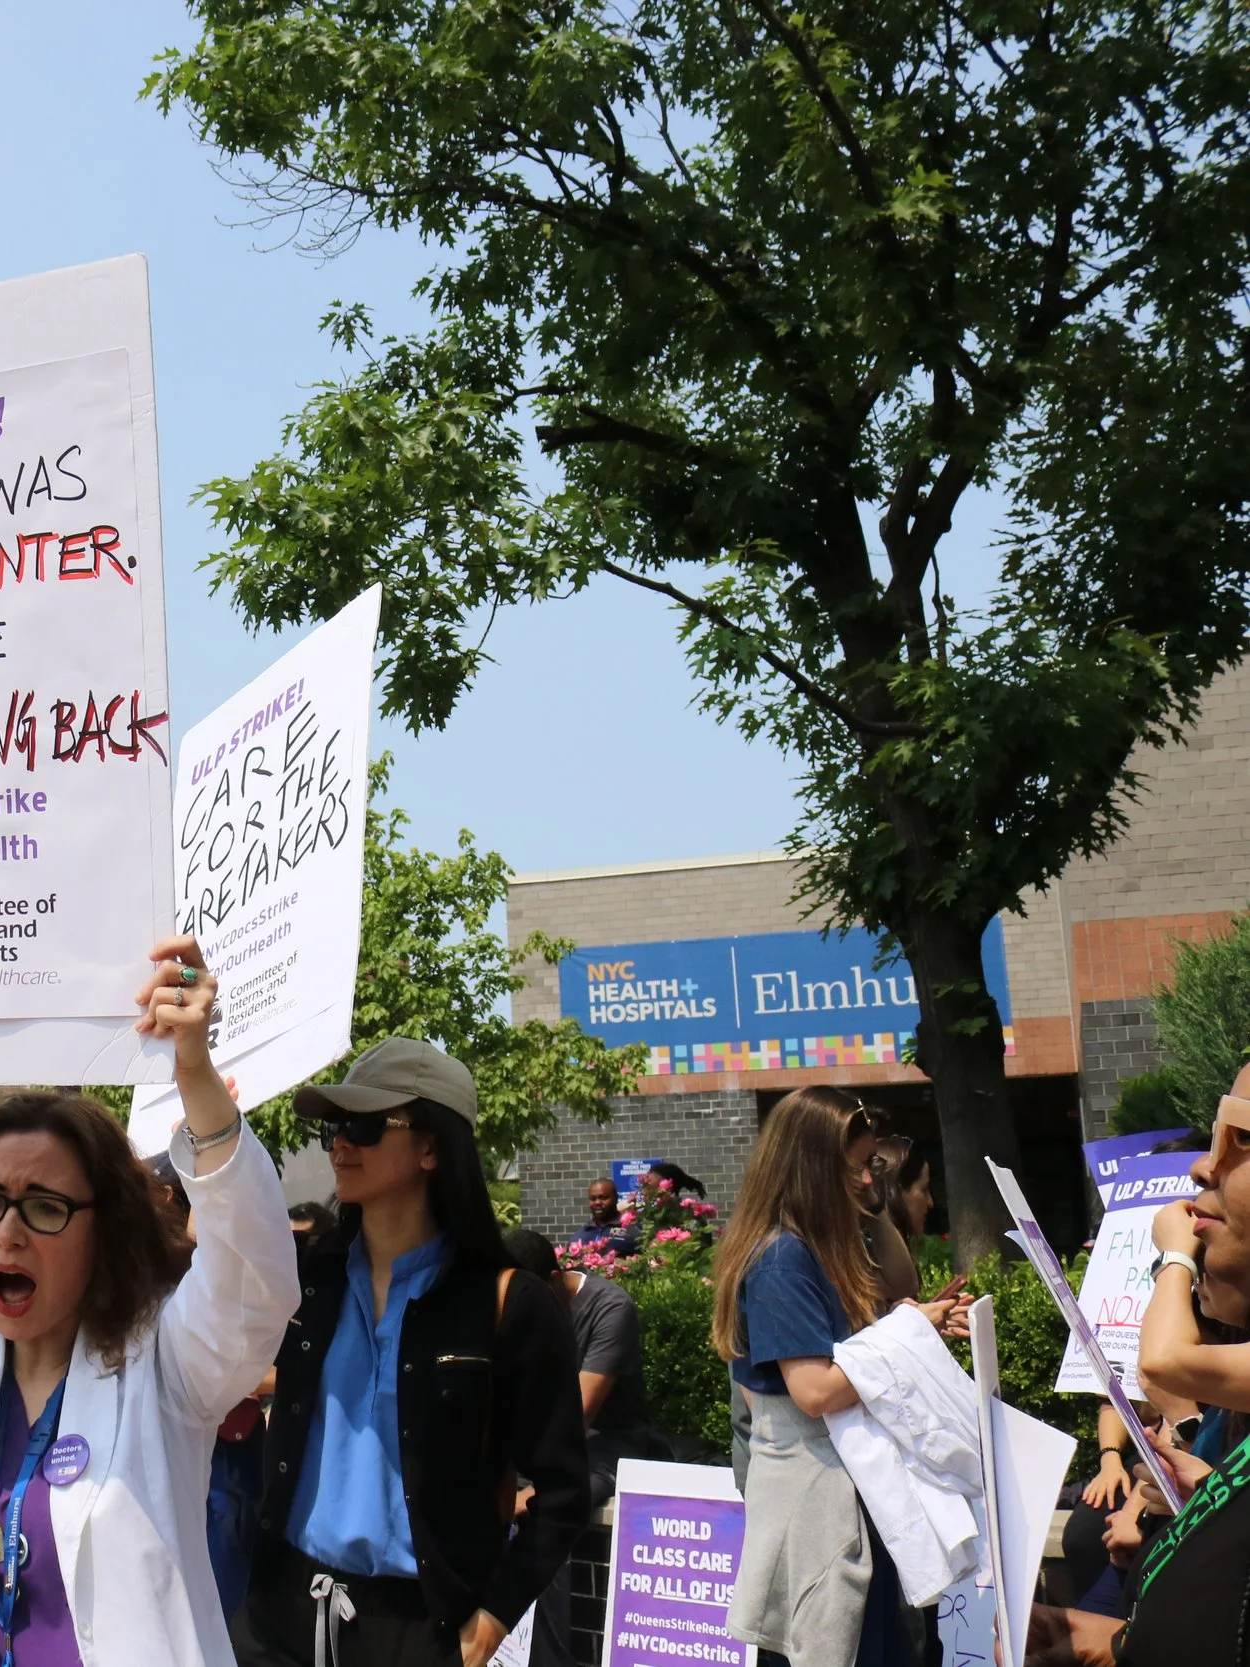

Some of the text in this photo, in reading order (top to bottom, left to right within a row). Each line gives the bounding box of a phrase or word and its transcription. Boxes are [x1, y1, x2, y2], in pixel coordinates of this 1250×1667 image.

[50, 689, 169, 767] BACK
[191, 677, 305, 786] ULP STRIKE!
[180, 700, 317, 850] CARE
[184, 729, 342, 899] FOR THE
[175, 779, 352, 938] ARETAKERS
[35, 893, 57, 914] of
[201, 891, 299, 961] NYCDocsStrike
[229, 950, 298, 999] Committee of
[587, 961, 635, 982] NYC
[228, 971, 287, 1014] Interns and
[227, 992, 277, 1028] Residents
[589, 997, 717, 1025] HOSPITALS
[1114, 1180, 1145, 1202] ULP
[1107, 1228, 1154, 1261] FAI
[1099, 1341, 1110, 1349] FOR
[1102, 1330, 1114, 1338] FOR
[51, 1454, 76, 1464] united.
[53, 1445, 82, 1455] Doctors
[9, 1497, 20, 1547] Elmhurst
[652, 1517, 711, 1540] WORLD
[633, 1544, 732, 1573] CLASS CARE
[621, 1572, 735, 1604] FOR ALL OF US
[617, 1631, 740, 1665] #NYCDocsStrike
